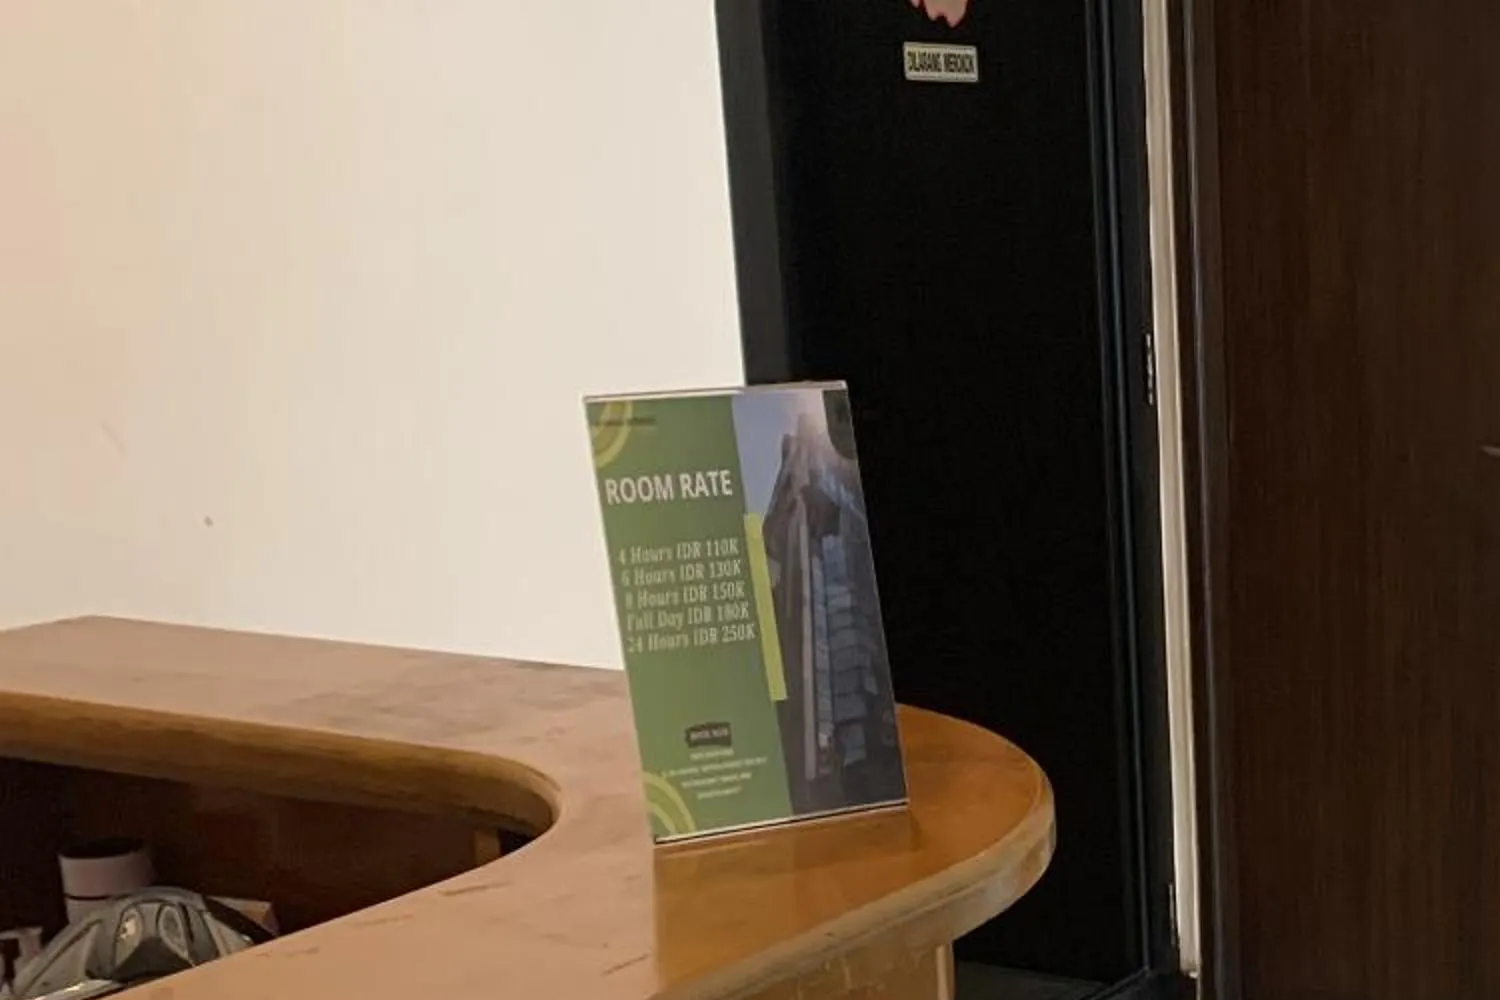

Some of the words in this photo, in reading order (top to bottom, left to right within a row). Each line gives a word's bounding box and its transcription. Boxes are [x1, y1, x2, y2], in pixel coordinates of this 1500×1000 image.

[605, 473, 675, 505] ROOM
[679, 469, 733, 499] RATE
[630, 546, 673, 565] Hours
[676, 542, 701, 560] IDR
[706, 538, 739, 557] 110K
[621, 569, 630, 586] 6
[634, 567, 676, 585] Hours
[680, 563, 704, 581] IDR
[709, 560, 741, 578] 130K
[637, 589, 679, 609] Hours
[683, 586, 707, 604] IDR
[712, 581, 745, 600] 150K
[627, 612, 653, 631] Full
[657, 610, 684, 631] Day
[687, 606, 712, 625] IDR
[648, 632, 689, 651] Hours
[693, 628, 717, 646] IDR
